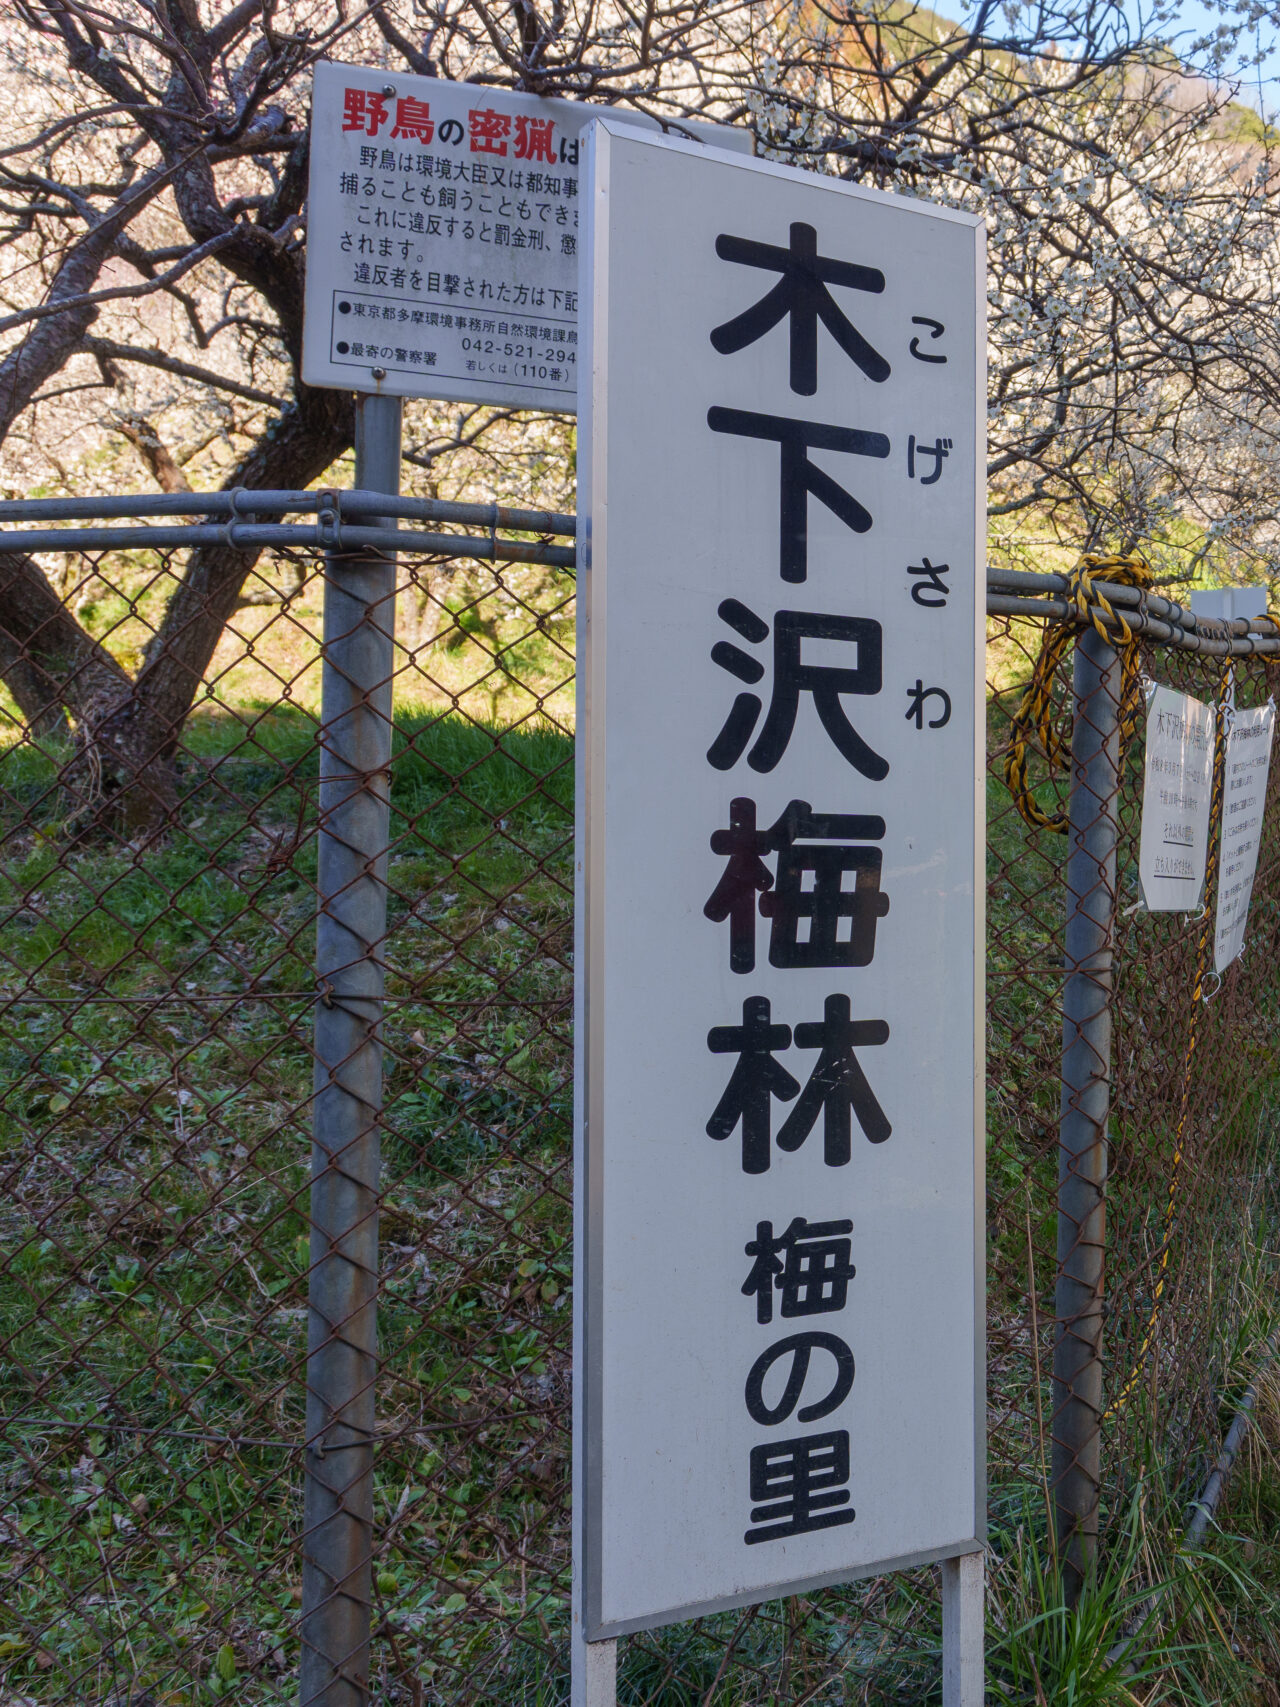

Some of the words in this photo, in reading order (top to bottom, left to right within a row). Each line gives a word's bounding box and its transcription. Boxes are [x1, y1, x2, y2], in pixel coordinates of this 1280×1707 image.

[342, 87, 578, 165] 野鳥の密猟は
[360, 145, 578, 199] 野鳥は環境大臣又は都知事
[340, 172, 578, 227] 捕ることも飼うこともでき
[340, 231, 424, 263] されます。
[357, 205, 577, 256] これに違反すると罰金刑、懲
[354, 261, 578, 312] 違反者を目撃された方は下記
[351, 342, 437, 367] 最寄の警察署
[461, 337, 577, 364] 042-521-294
[907, 315, 952, 731] こげさわ
[706, 221, 892, 1176] 木下沢梅林
[741, 1216, 857, 1546] 梅の里
